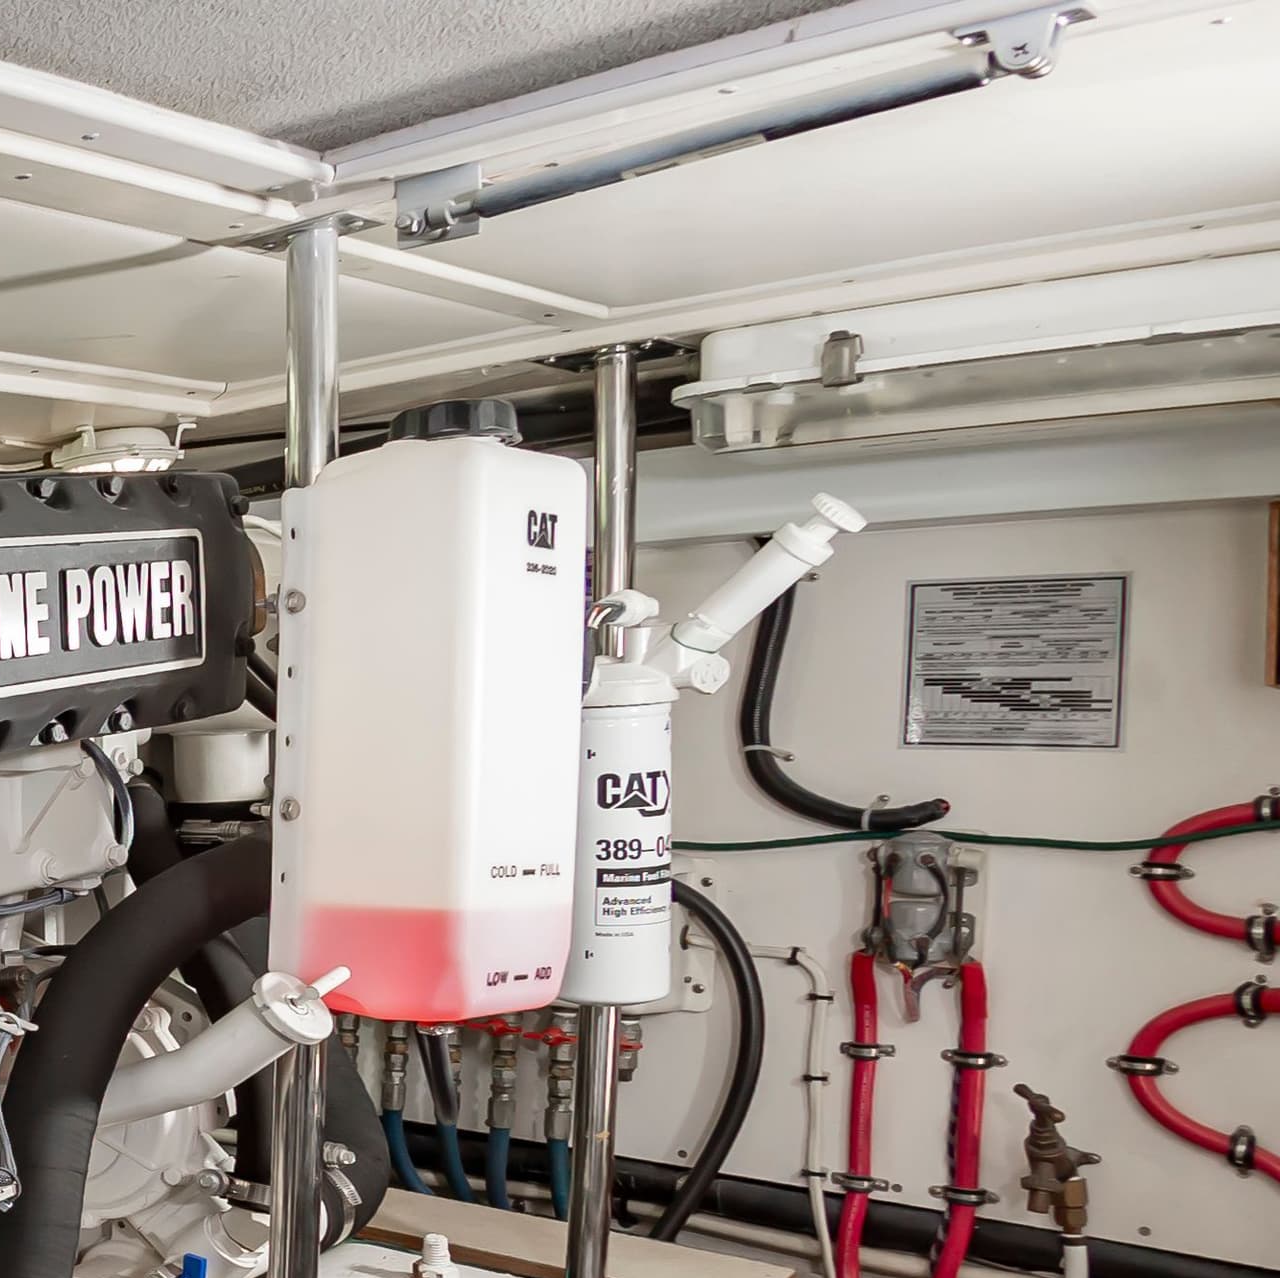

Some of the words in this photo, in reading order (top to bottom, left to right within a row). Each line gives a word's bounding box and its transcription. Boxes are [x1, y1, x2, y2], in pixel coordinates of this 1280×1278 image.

[527, 509, 558, 550] CAT
[61, 558, 195, 652] POWER
[596, 771, 662, 810] CAT
[490, 865, 518, 879] COLD
[540, 863, 561, 876] FULL
[602, 896, 652, 906] Advanced
[602, 907, 628, 918] High
[486, 971, 509, 987] LOW
[534, 966, 552, 981] ADD
